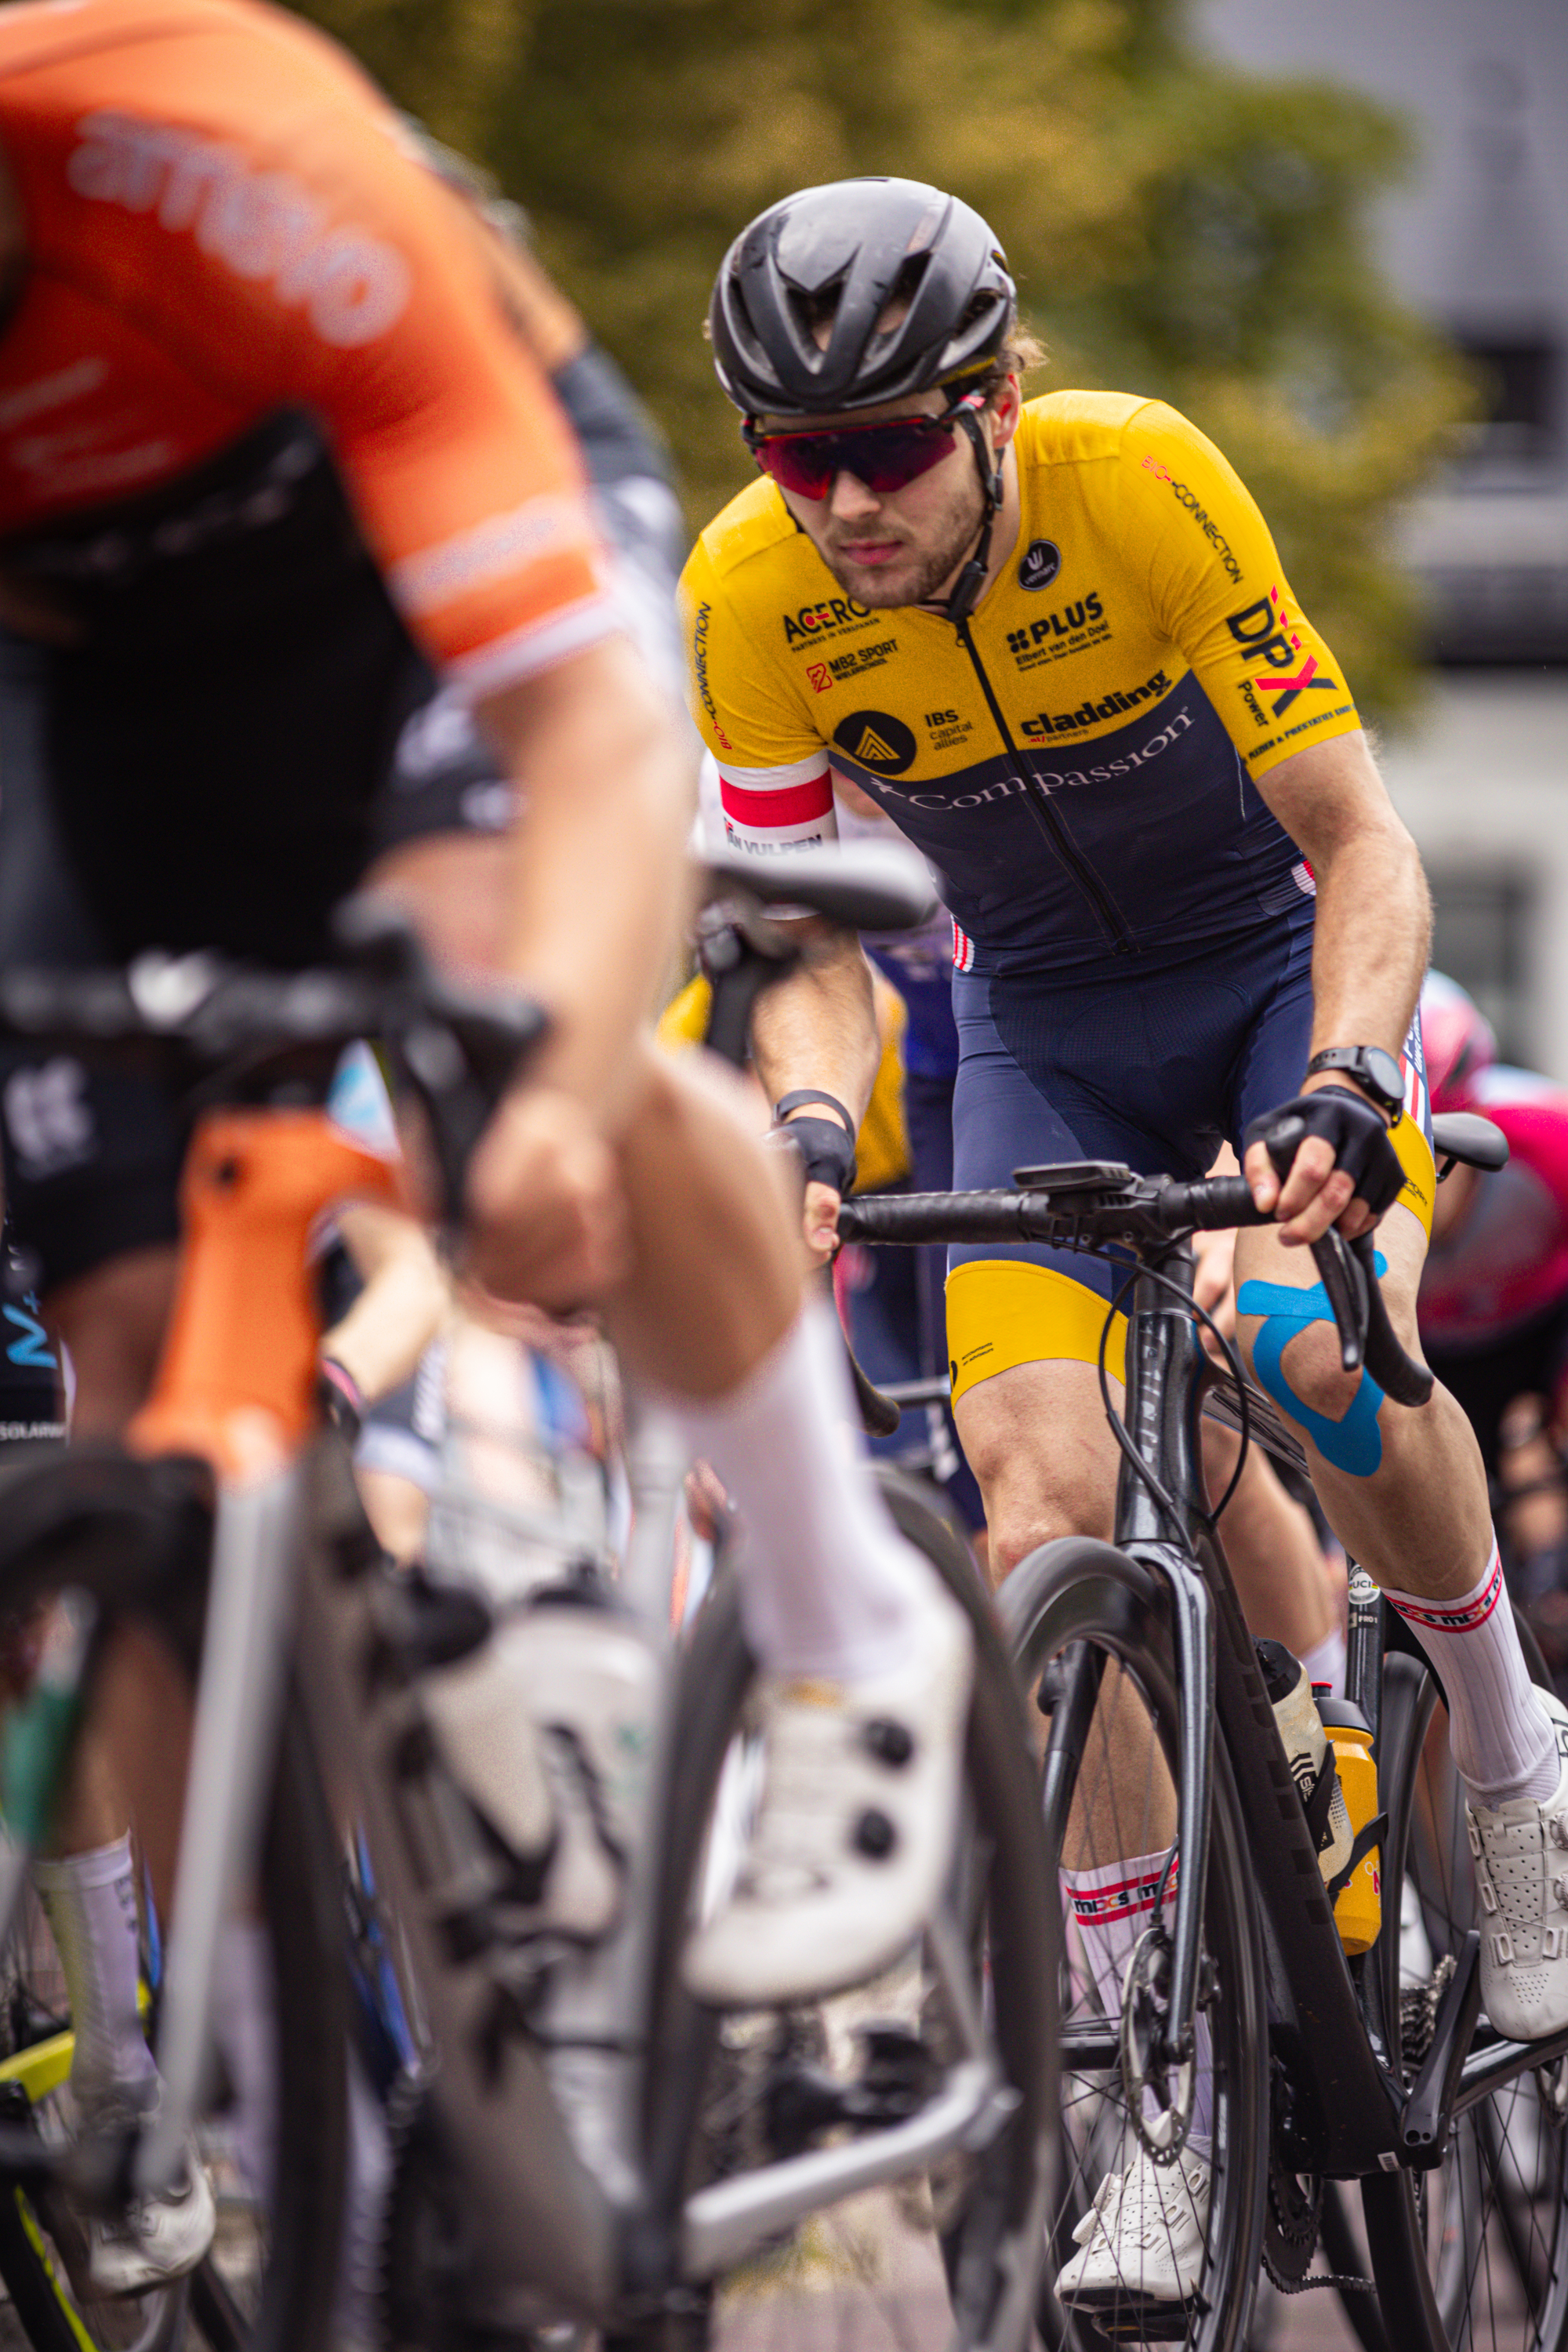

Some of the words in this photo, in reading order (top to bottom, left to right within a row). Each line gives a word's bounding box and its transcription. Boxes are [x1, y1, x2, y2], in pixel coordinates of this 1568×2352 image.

[1029, 591, 1103, 644] PLUS
[1048, 641, 1067, 652] van
[1068, 633, 1087, 645] den
[829, 653, 858, 673] MB2
[857, 639, 898, 662] SPORT
[1020, 669, 1173, 735] cladding
[1238, 680, 1269, 728] Power
[925, 710, 959, 728] IBS
[929, 720, 974, 740] capital
[934, 735, 968, 751] allies
[743, 833, 823, 856] VULPEN
[1405, 1178, 1428, 1207] PORT
[1352, 1580, 1371, 1589] UCI
